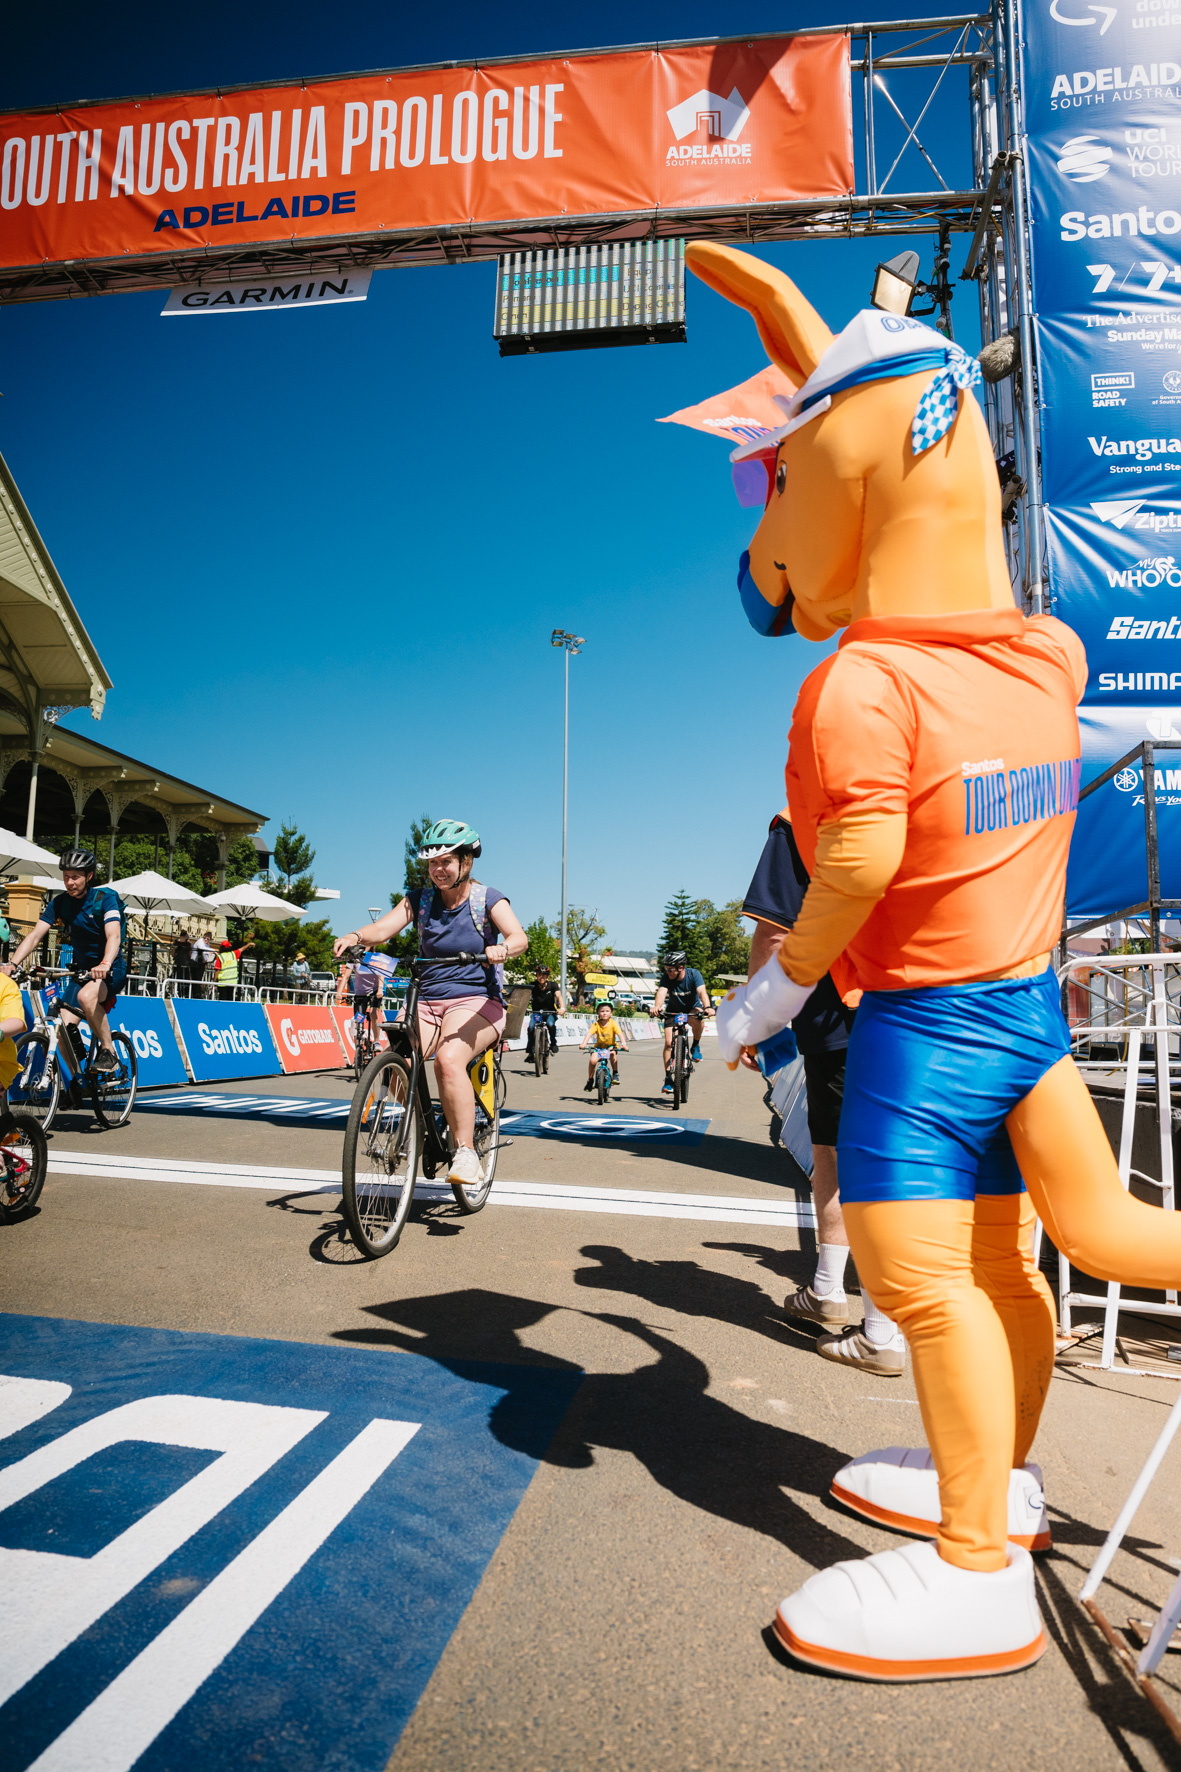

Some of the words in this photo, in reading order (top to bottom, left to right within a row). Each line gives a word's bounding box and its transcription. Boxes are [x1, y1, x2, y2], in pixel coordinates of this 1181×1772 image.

[1050, 62, 1181, 98] ADELAID
[1050, 93, 1105, 111] SOUTH
[1125, 128, 1167, 145] UCI
[1, 128, 103, 210] OUTH
[110, 105, 328, 198] AUSTRALIA
[341, 83, 565, 175] PROLOGUE
[666, 144, 752, 159] ADELAIDE
[666, 159, 697, 167] SOUTH
[700, 158, 752, 166] AUSTRALIA
[1128, 161, 1181, 178] TOUR
[153, 190, 356, 233] ADELAIDE
[1060, 206, 1181, 242] Santo
[181, 278, 349, 308] GARMIN
[1083, 314, 1113, 328] The
[1107, 329, 1163, 343] Sunday
[1141, 342, 1164, 350] We're
[1164, 342, 1177, 350] for
[1096, 376, 1130, 386] THINK!
[1092, 391, 1120, 400] ROAD
[1092, 398, 1127, 408] SAFETY
[702, 414, 762, 427] Santos
[1087, 436, 1181, 461] Vangua
[1109, 465, 1142, 474] Strong
[1144, 463, 1162, 472] and
[961, 758, 1005, 777] Santos
[963, 773, 1008, 835] TOUR
[1009, 763, 1057, 826] DOWN
[197, 1022, 263, 1055] Santos
[297, 1029, 335, 1044] GATORADE
